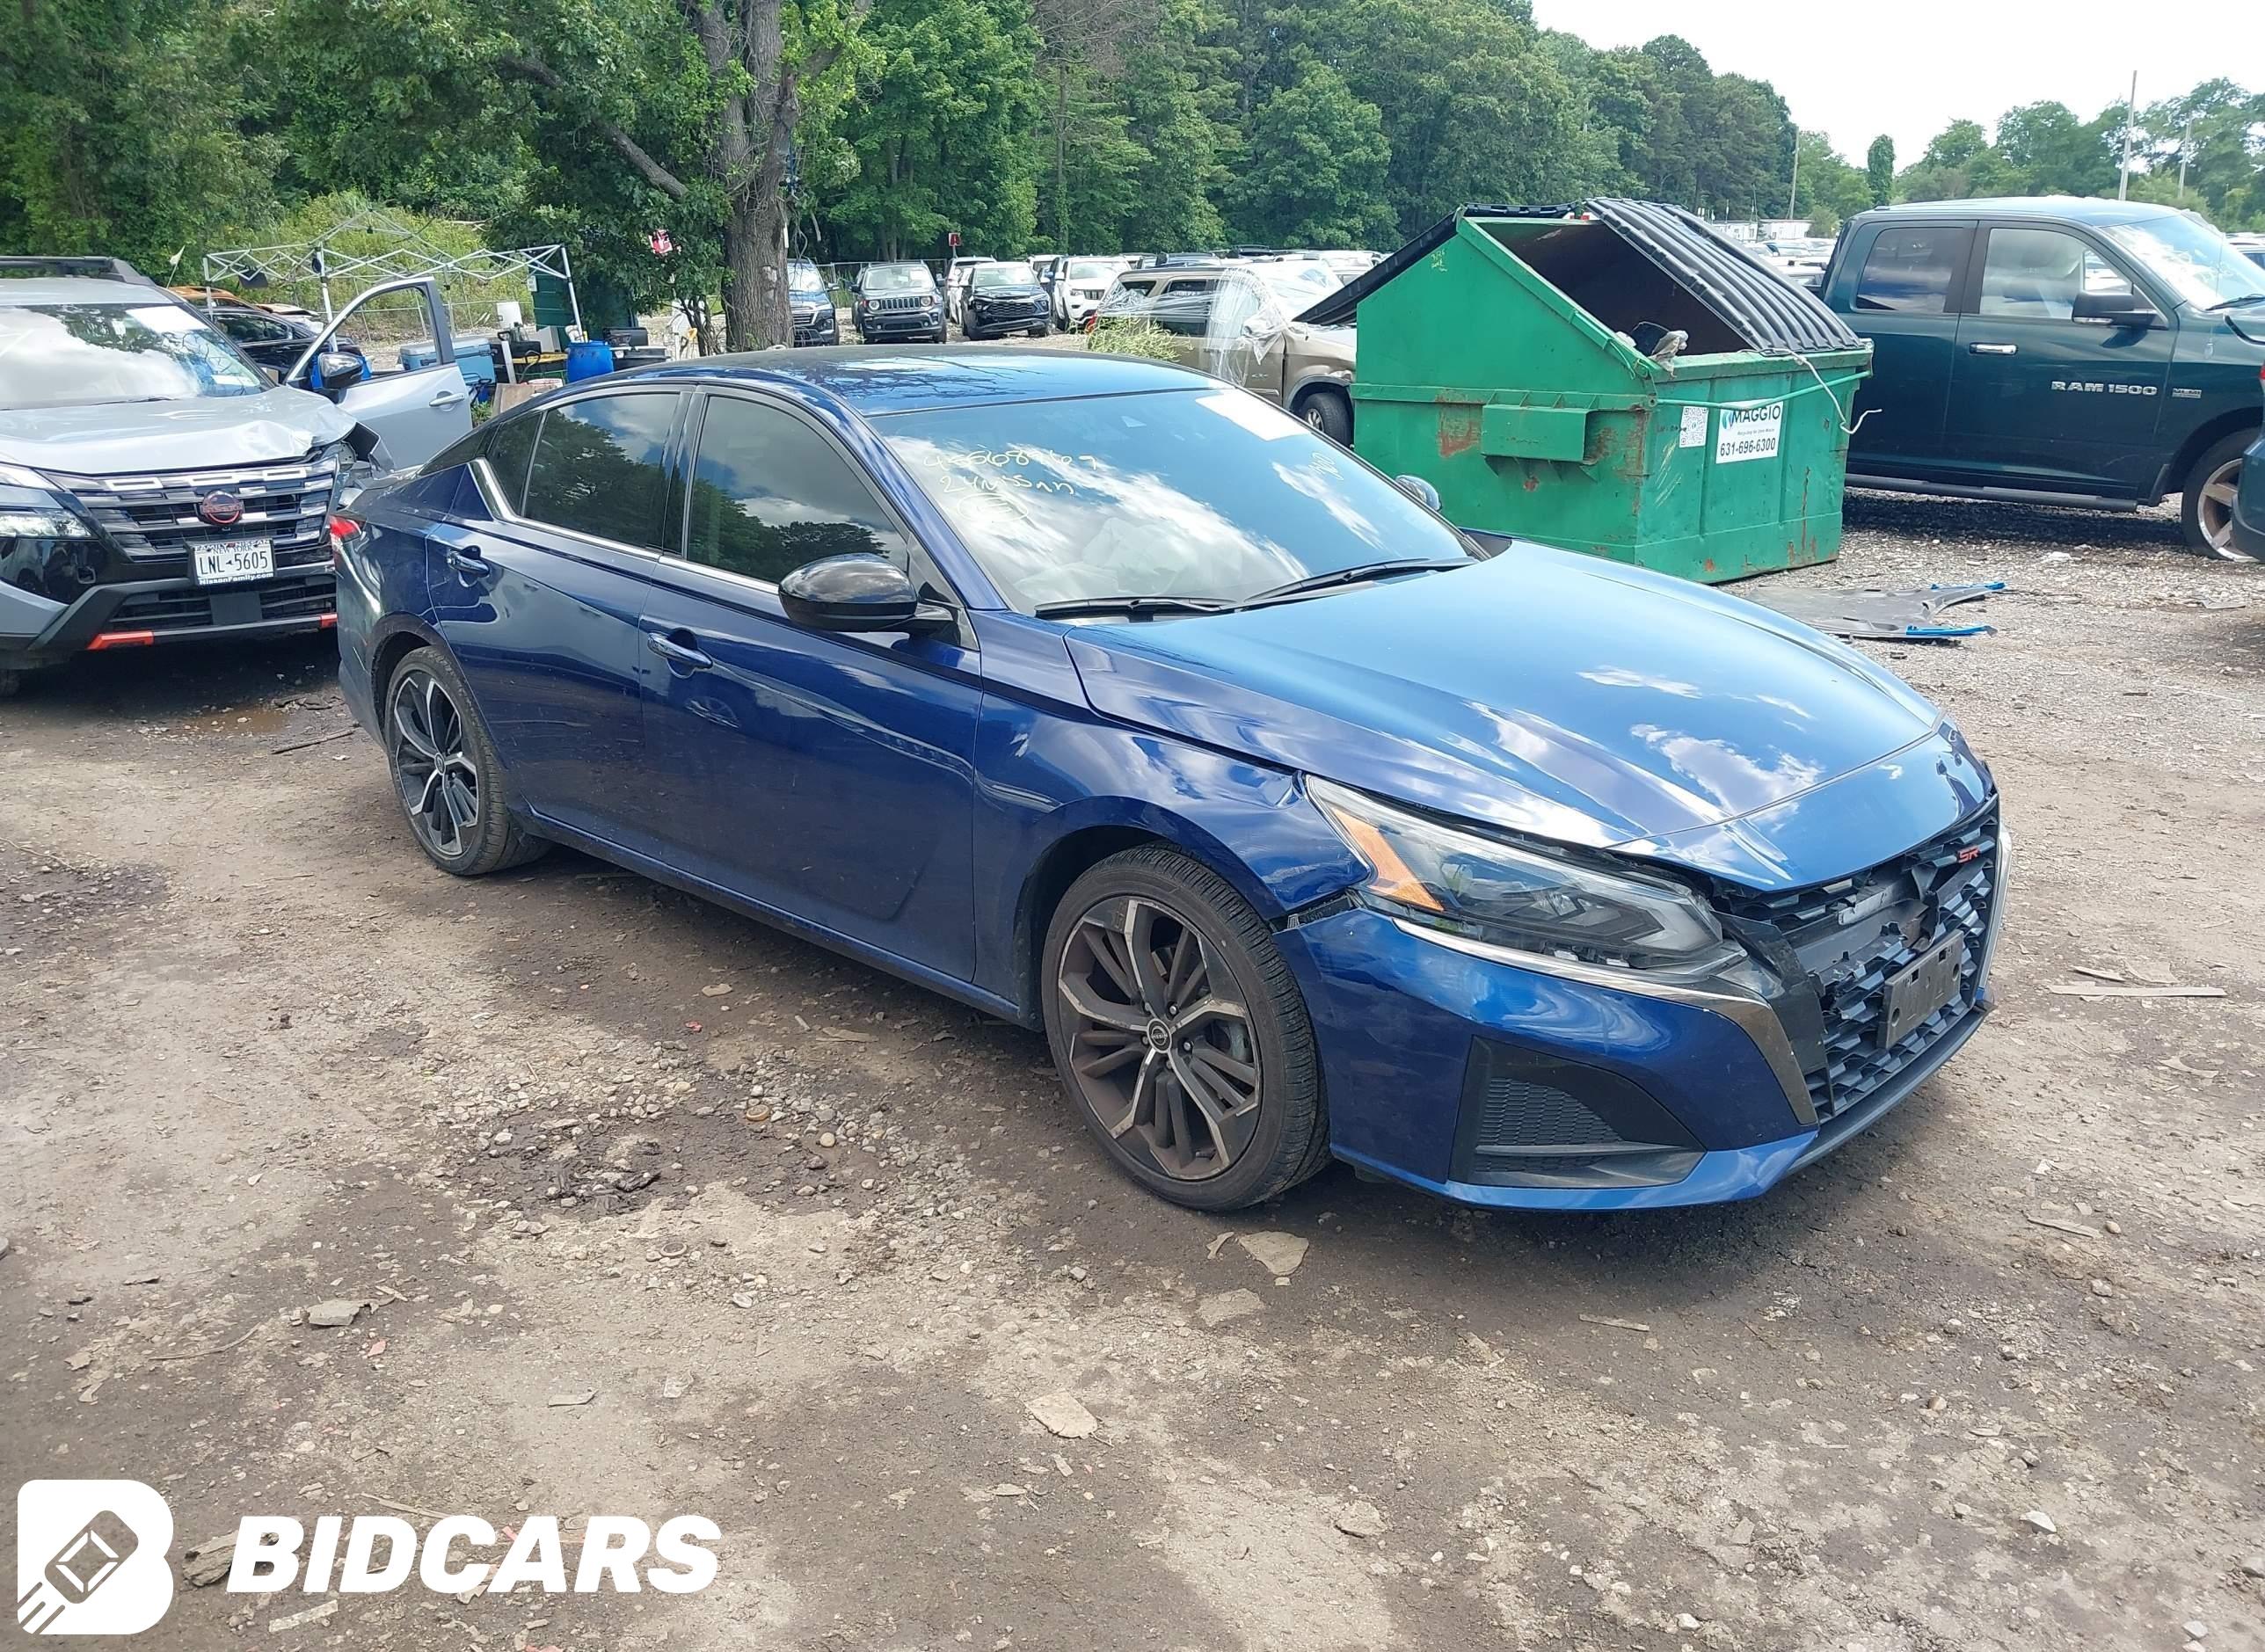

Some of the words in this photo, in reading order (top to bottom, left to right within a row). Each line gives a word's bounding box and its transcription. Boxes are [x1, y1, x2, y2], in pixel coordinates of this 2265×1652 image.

[2050, 381, 2104, 393] RAM
[2108, 383, 2158, 396] 1500
[1731, 405, 1781, 424] MAGGIO
[1720, 437, 1776, 457] 631-696-6300
[200, 555, 225, 575] LNL
[235, 550, 268, 571] 5605
[1957, 845, 1979, 863] SR
